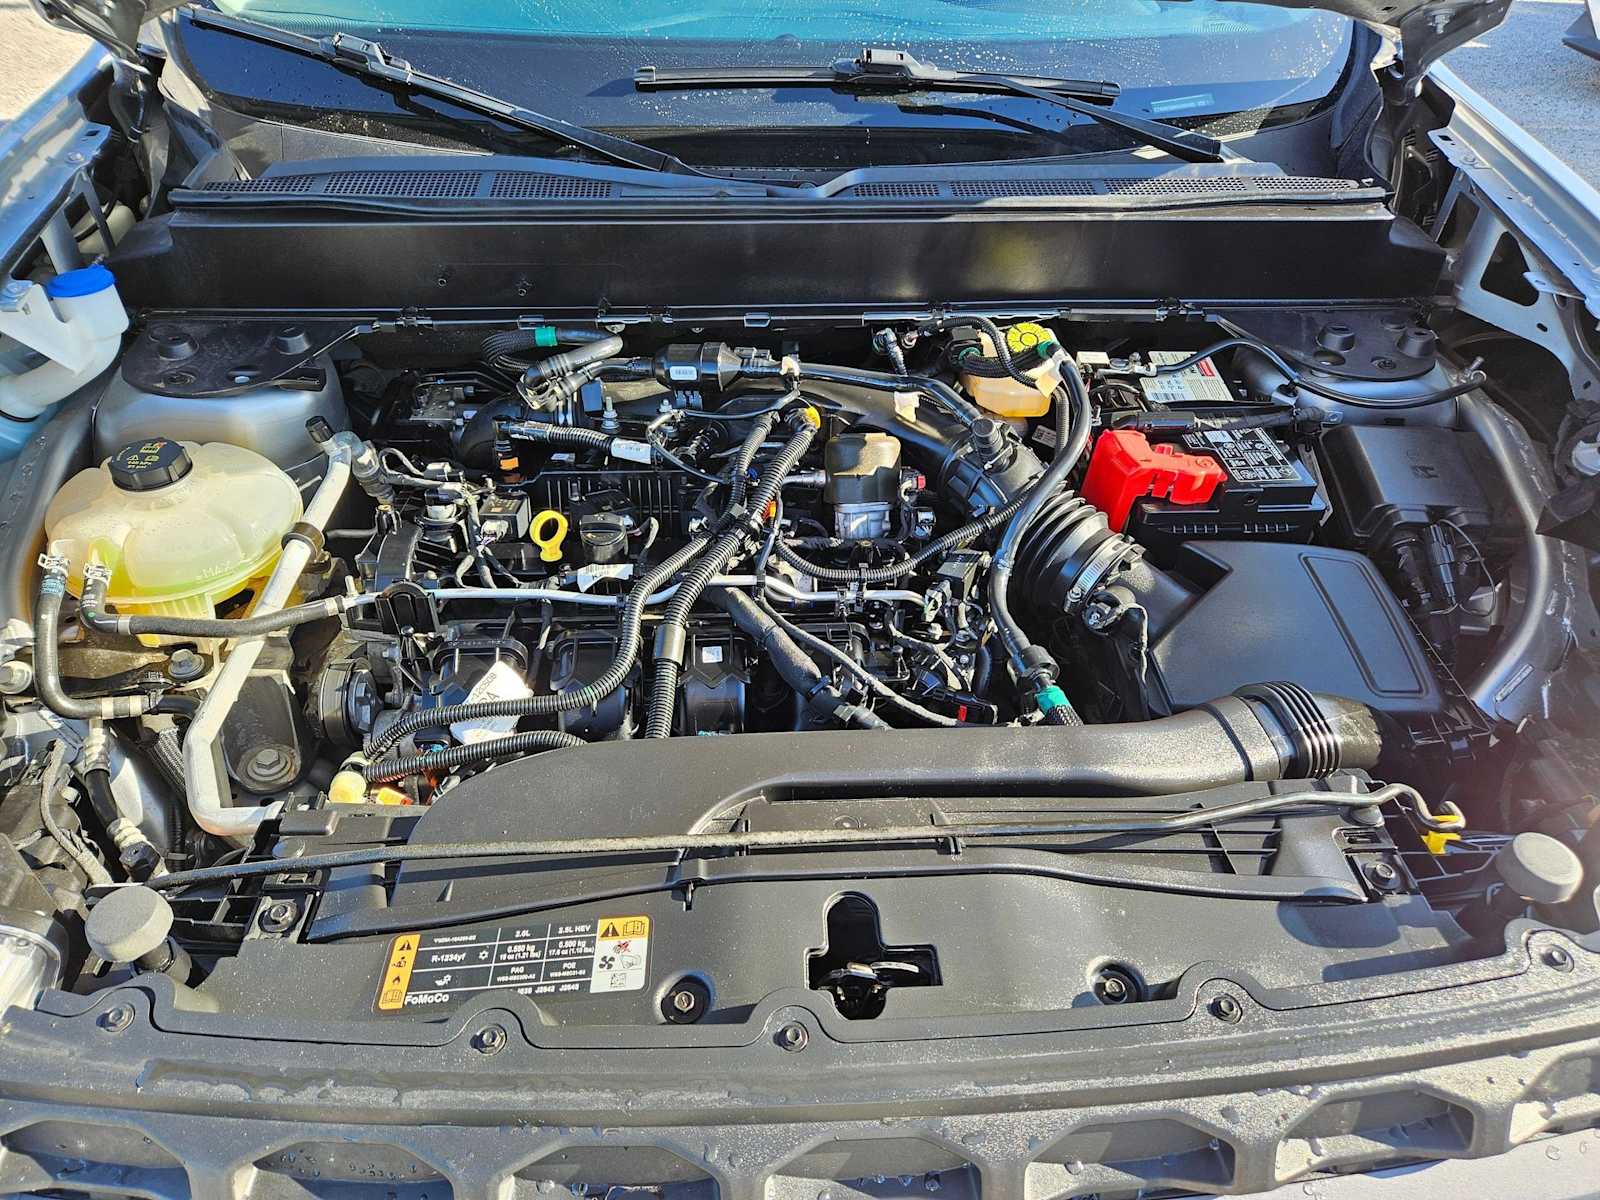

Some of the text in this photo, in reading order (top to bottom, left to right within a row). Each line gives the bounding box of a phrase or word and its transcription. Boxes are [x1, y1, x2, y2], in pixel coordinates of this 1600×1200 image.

[578, 940, 586, 948] kg
[431, 952, 466, 963] R-1234yf
[404, 993, 450, 1005] FoMoCo
